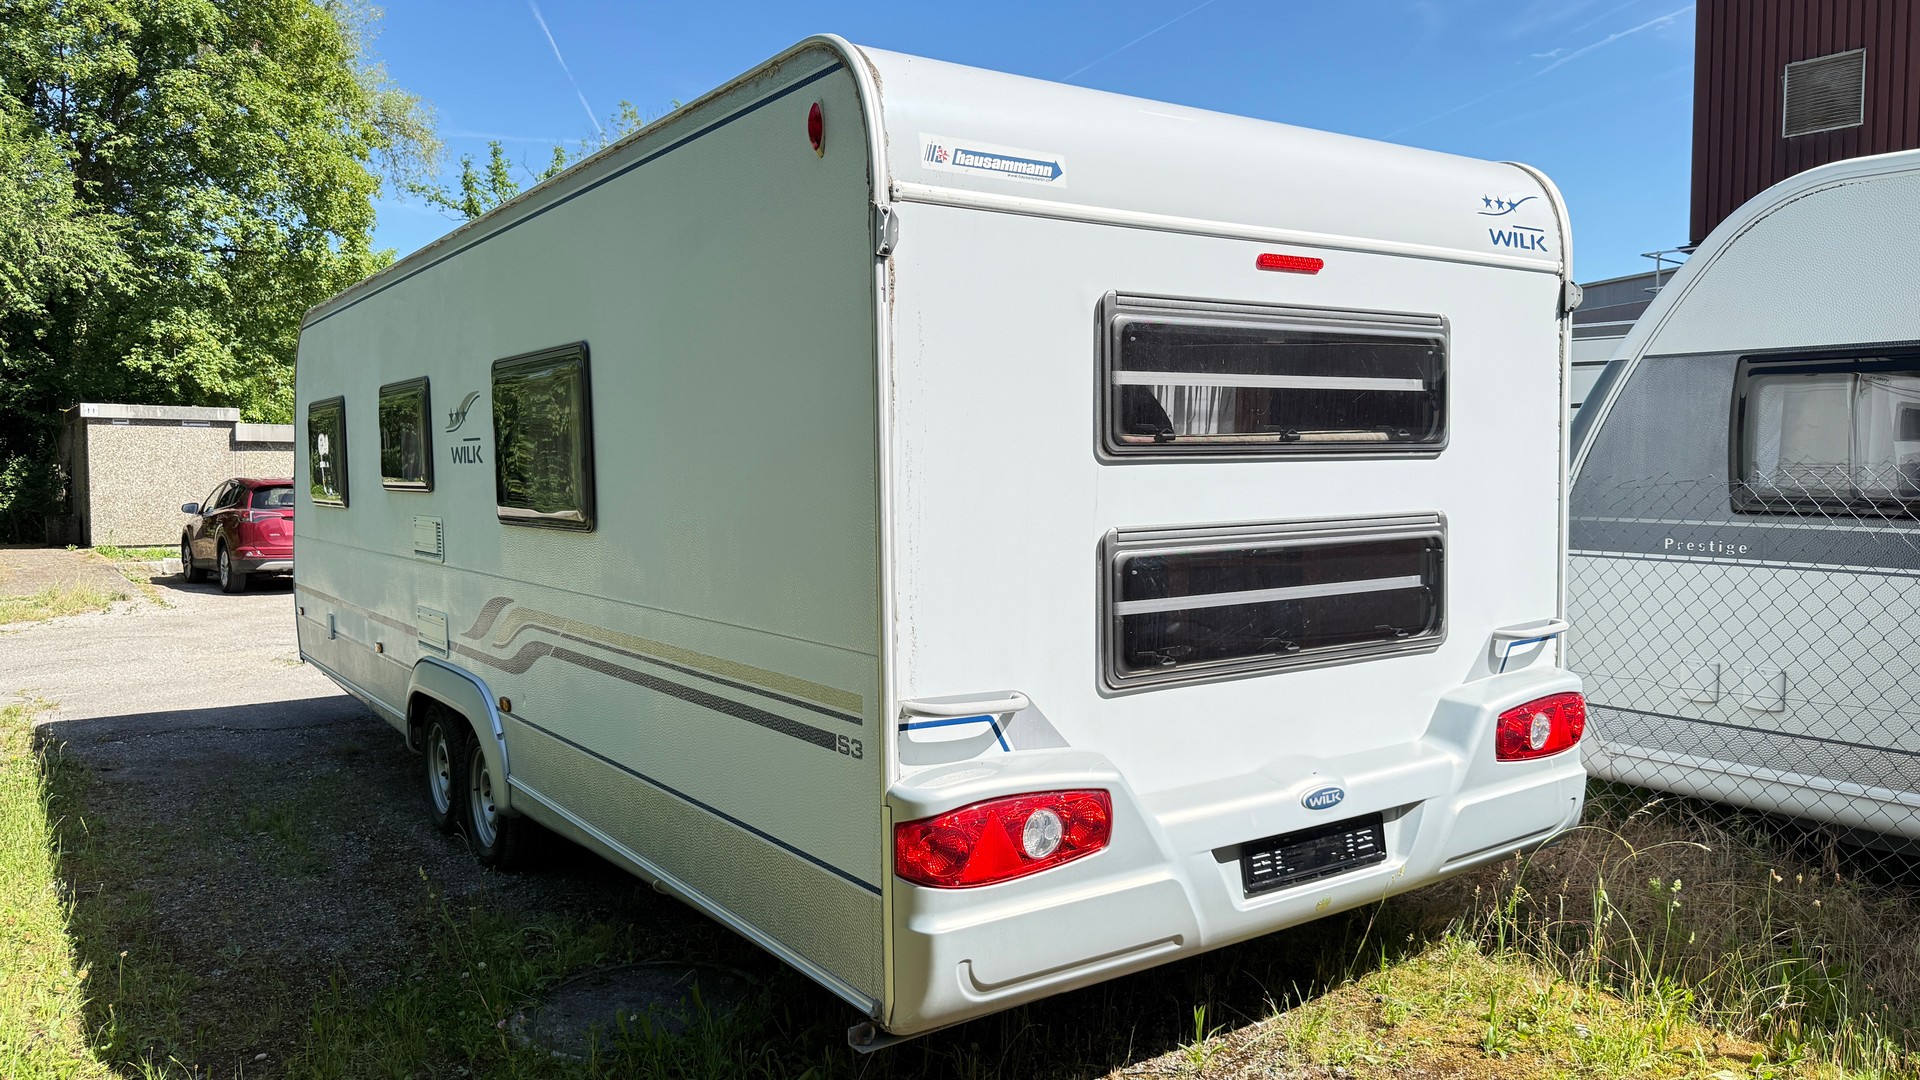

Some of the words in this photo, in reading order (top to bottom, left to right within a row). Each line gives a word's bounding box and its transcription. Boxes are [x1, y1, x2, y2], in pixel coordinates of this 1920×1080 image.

[956, 150, 1053, 177] hausammann
[1488, 228, 1548, 253] WILK
[451, 445, 483, 465] WILK
[1664, 537, 1748, 556] Prestige
[837, 734, 864, 760] S3
[1309, 791, 1342, 808] WILK
